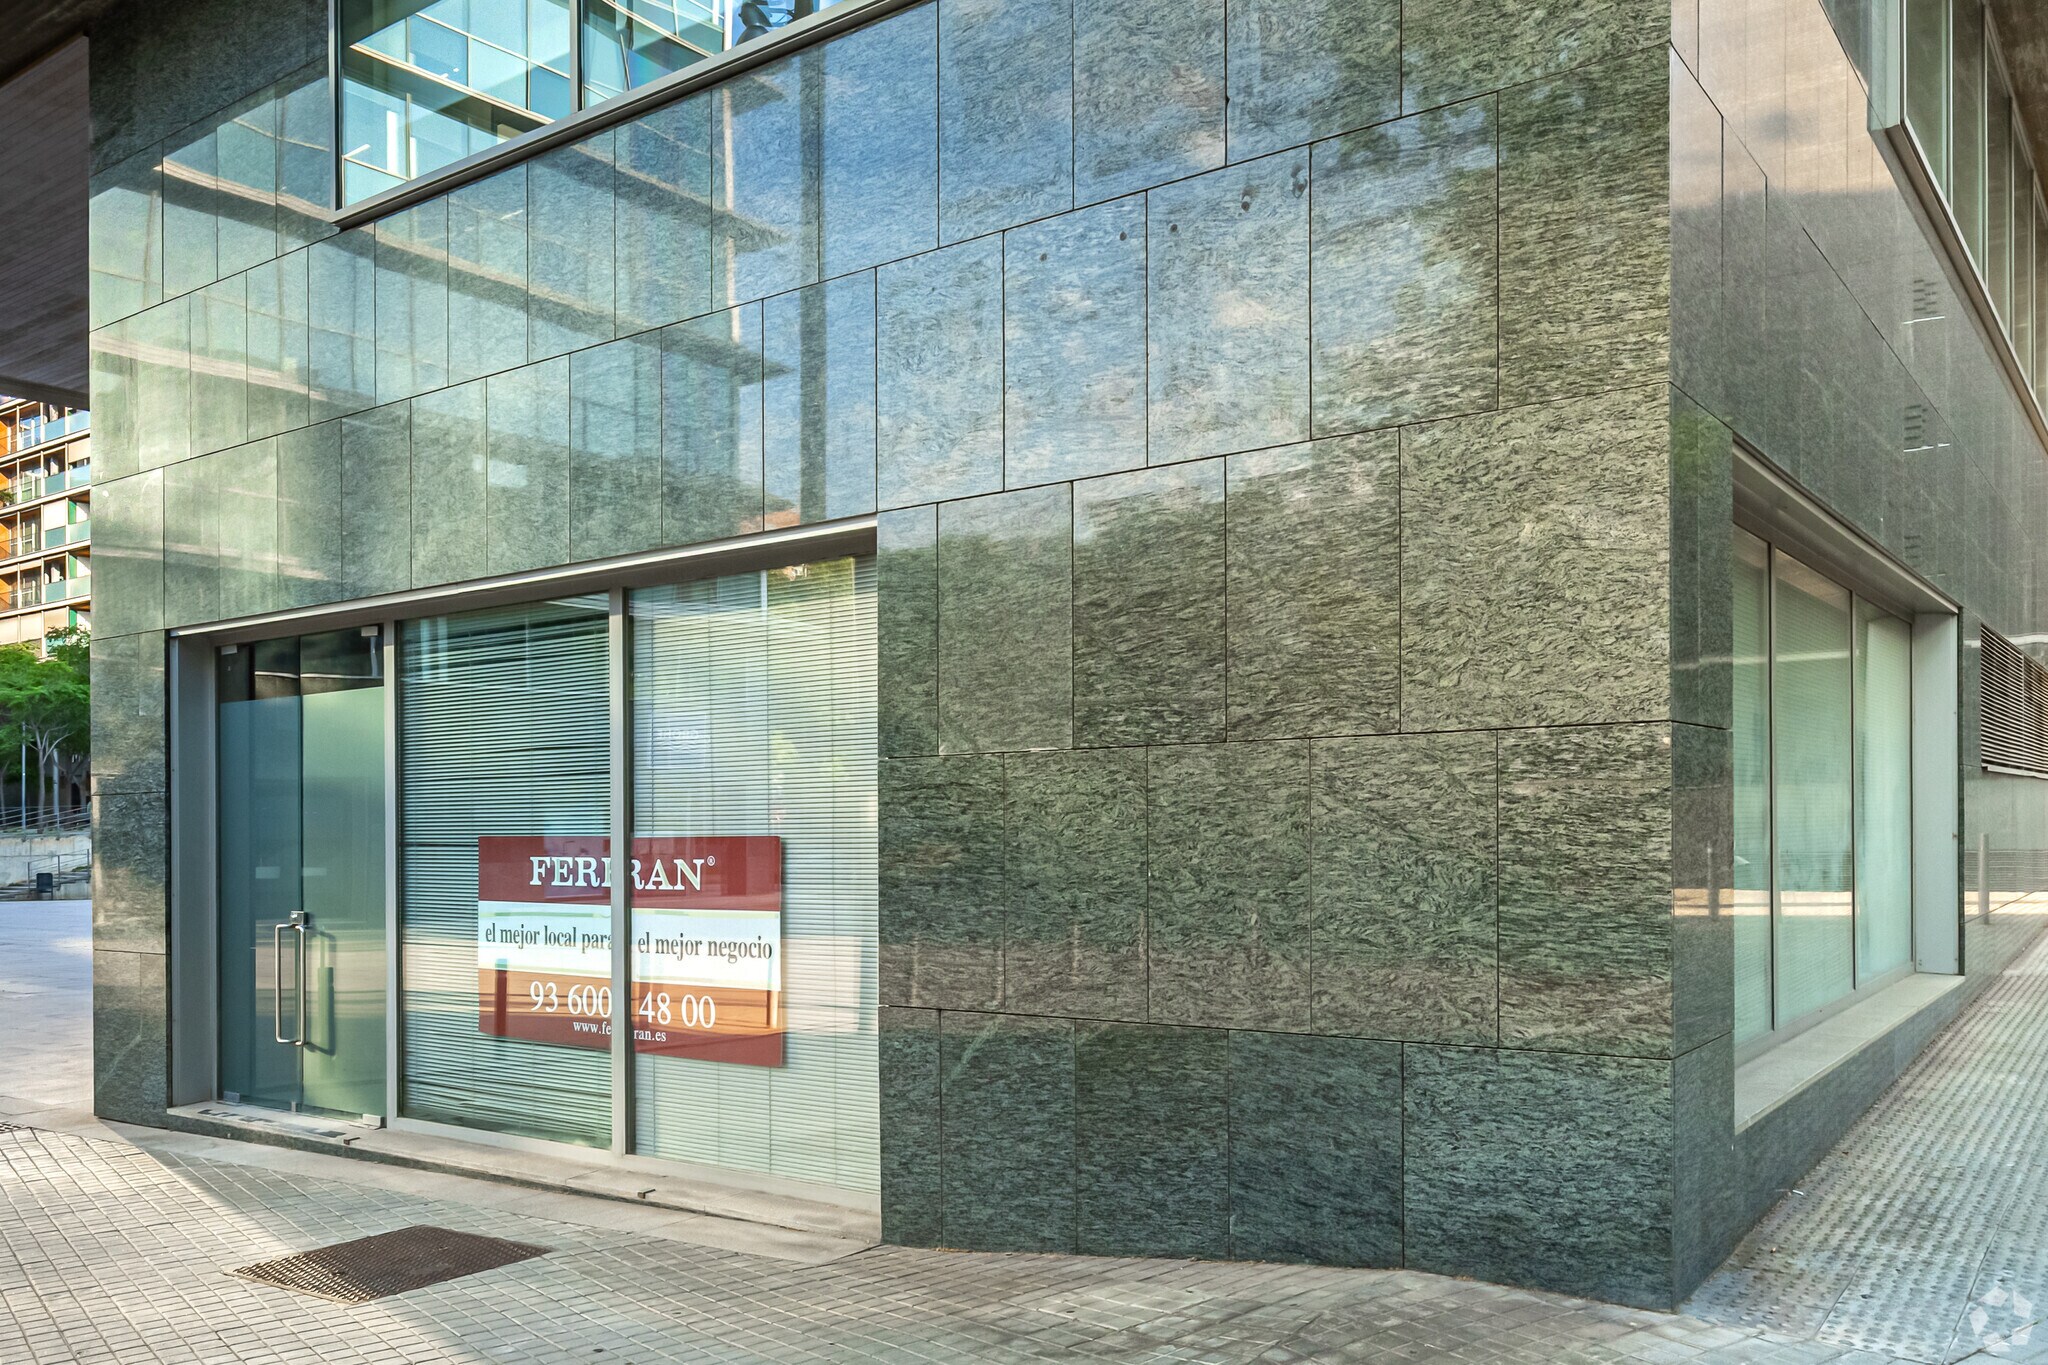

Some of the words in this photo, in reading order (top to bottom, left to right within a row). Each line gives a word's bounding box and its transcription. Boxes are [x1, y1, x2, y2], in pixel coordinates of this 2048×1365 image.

[485, 922, 496, 943] el
[500, 923, 540, 949] mejor
[544, 925, 577, 947] local
[638, 931, 650, 954] el
[655, 932, 702, 961] mejor
[707, 935, 773, 964] negocio
[530, 981, 558, 1013] 93
[567, 984, 612, 1018] 600
[638, 991, 672, 1025] 48
[681, 994, 716, 1028] 00
